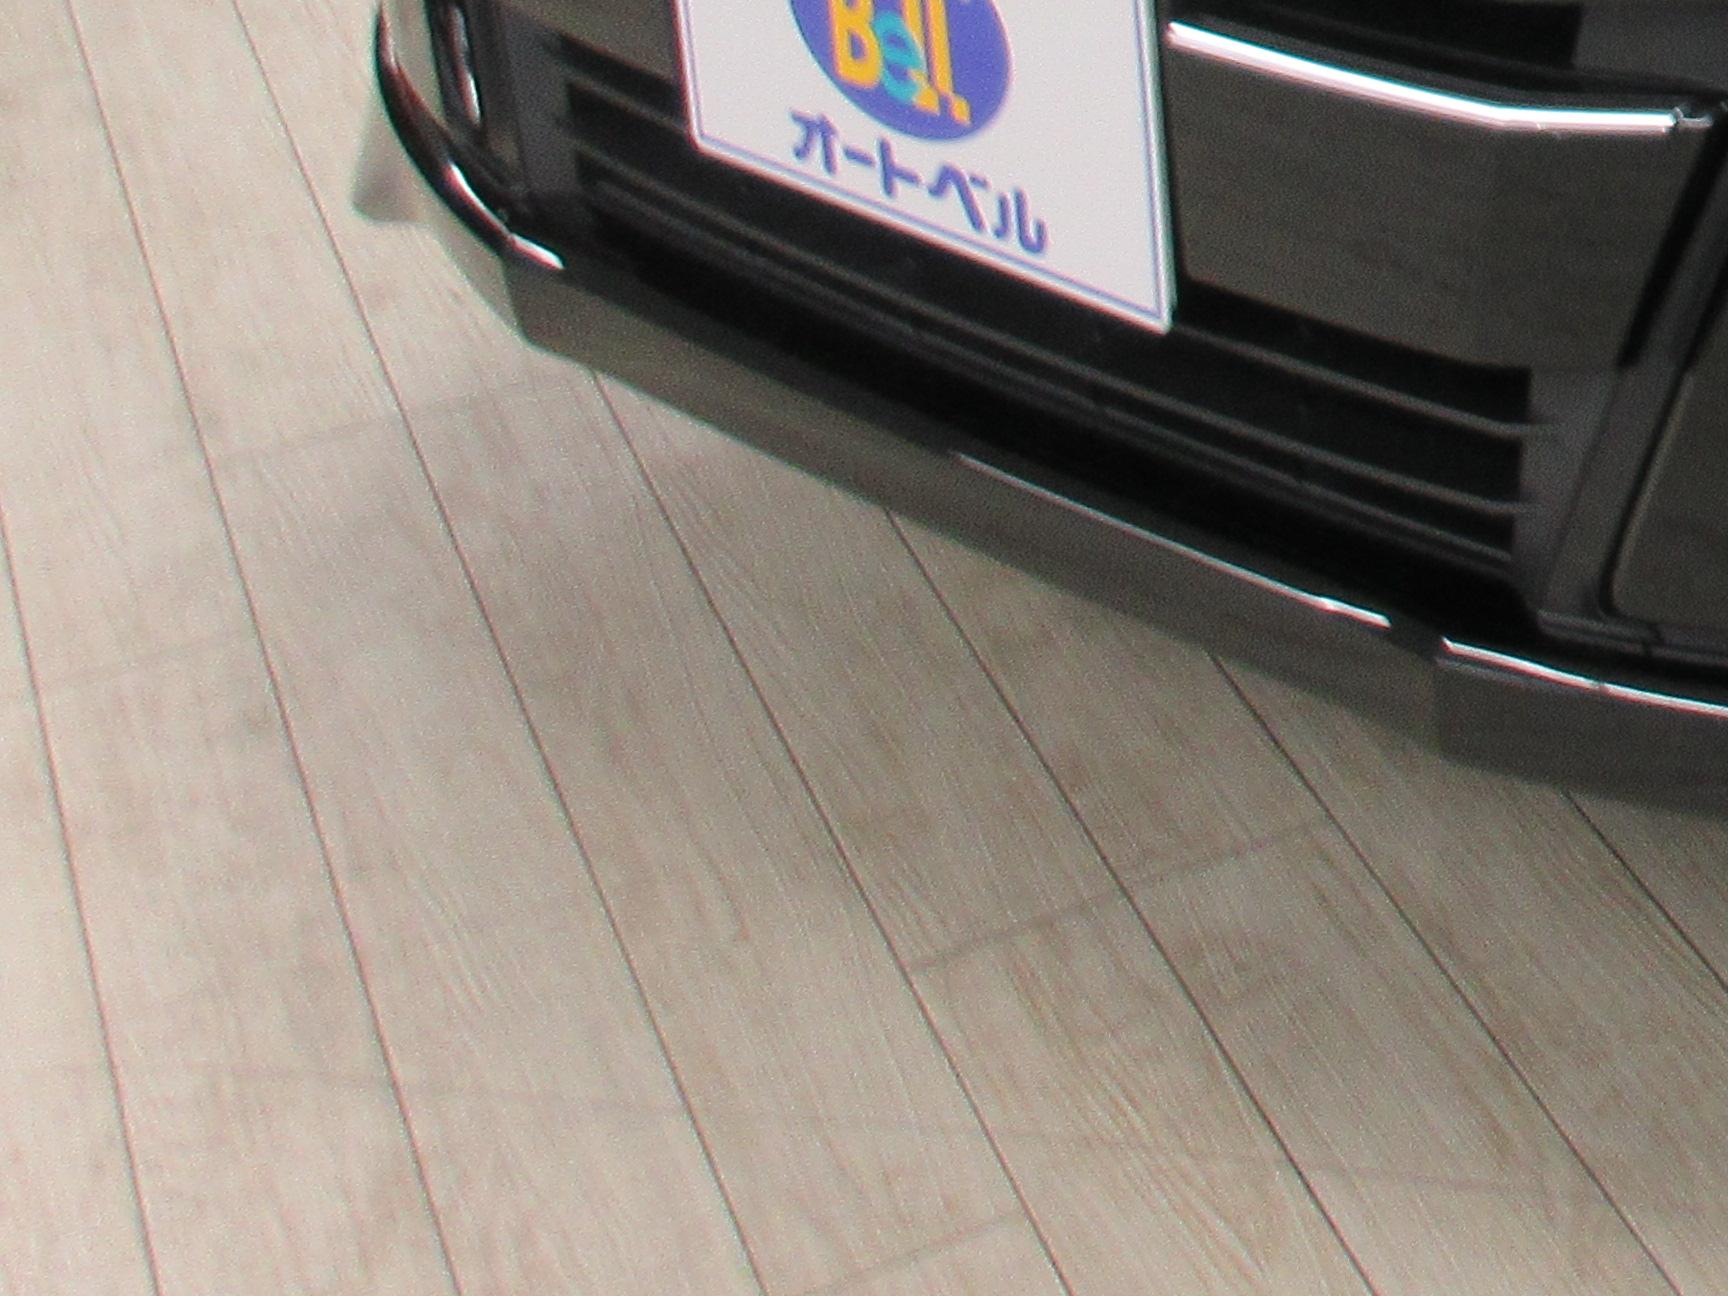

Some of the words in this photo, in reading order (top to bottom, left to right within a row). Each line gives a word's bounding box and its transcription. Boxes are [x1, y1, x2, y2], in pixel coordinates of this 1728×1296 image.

[791, 110, 1048, 254] オートベル
